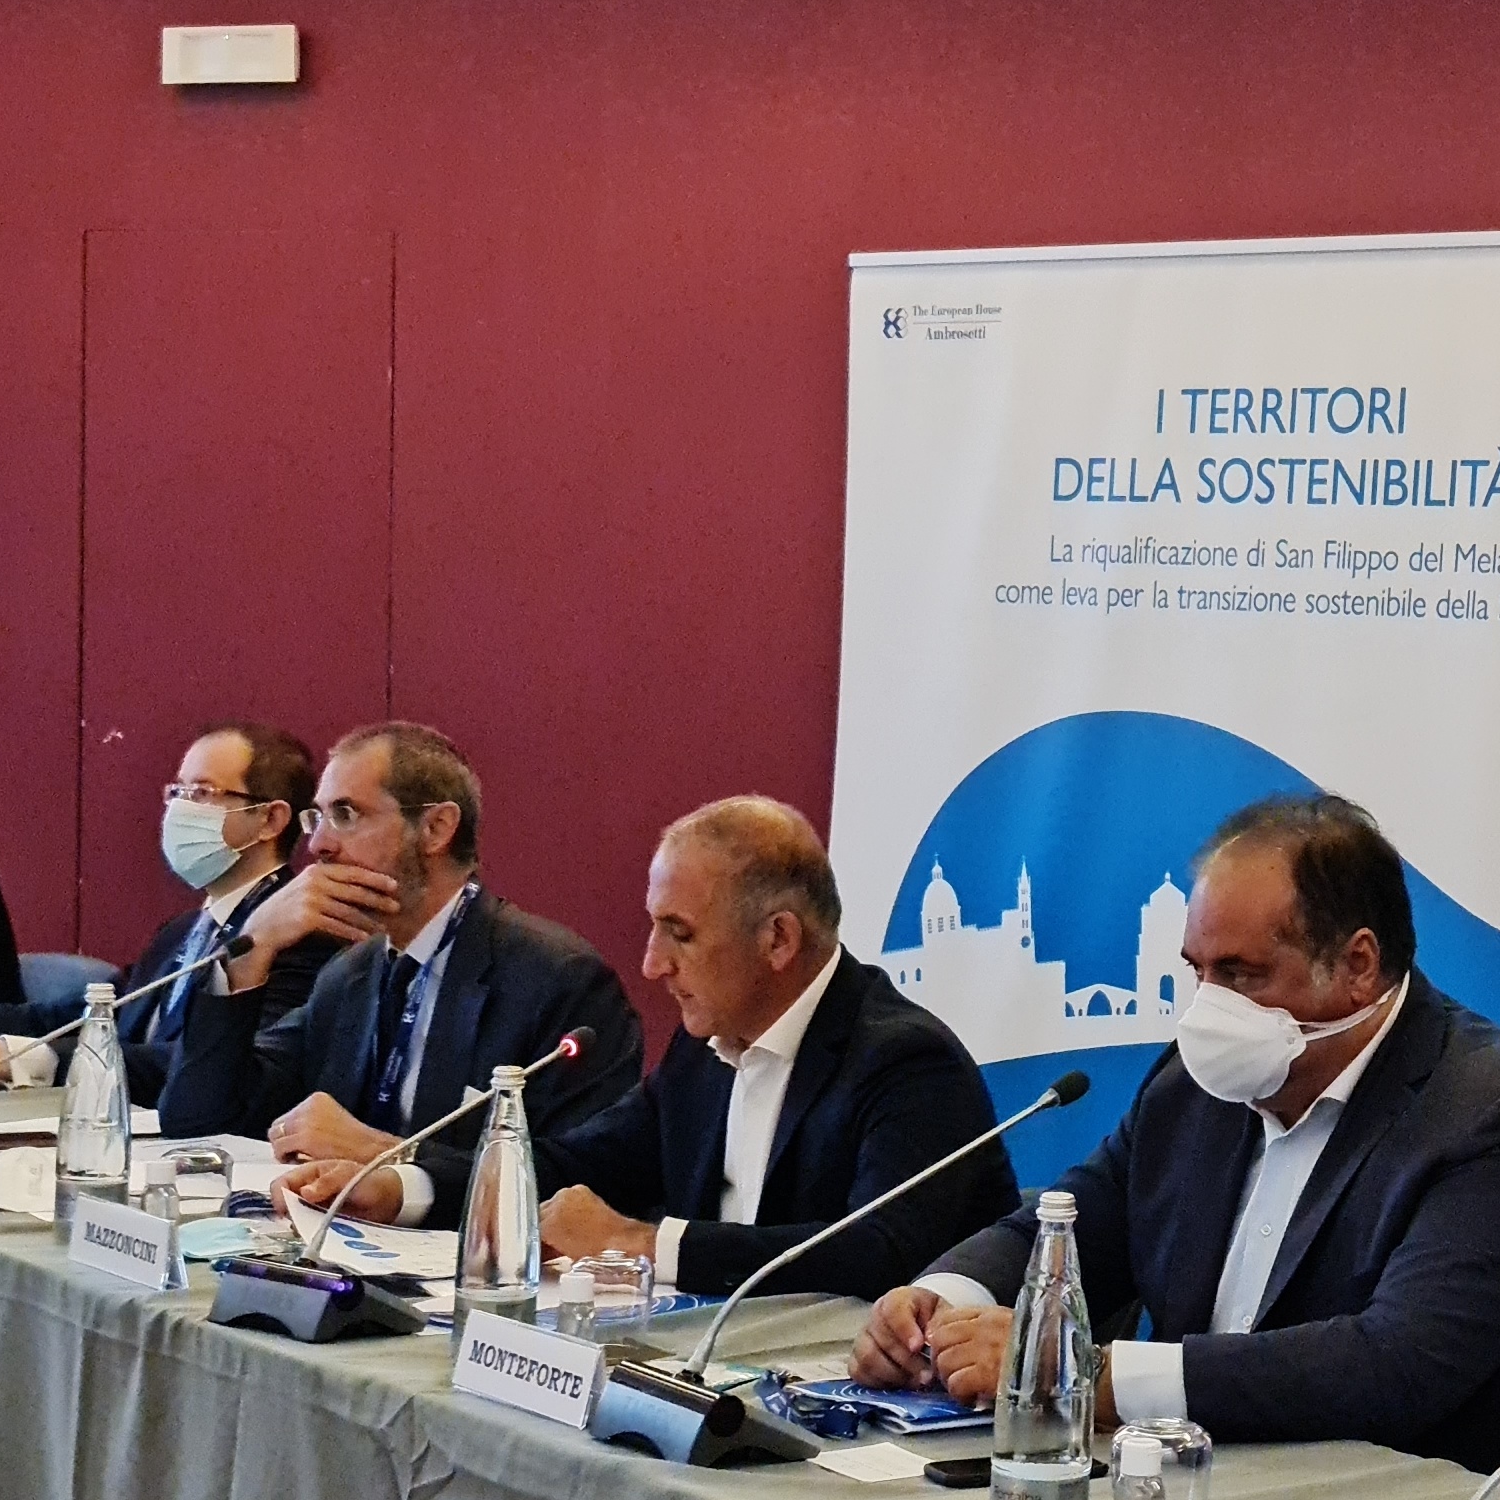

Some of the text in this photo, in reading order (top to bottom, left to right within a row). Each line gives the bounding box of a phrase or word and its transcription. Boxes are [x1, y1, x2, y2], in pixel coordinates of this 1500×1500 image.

[912, 303, 1002, 319] The European House
[925, 326, 986, 341] Ambrosetti
[1155, 386, 1407, 436] I TERRITORI
[1052, 457, 1181, 504] DELLA
[1050, 534, 1074, 564] La
[1081, 535, 1239, 574] riqualificazione
[1246, 538, 1266, 568] di
[1274, 538, 1314, 569] San
[1323, 539, 1399, 580] Filippo
[1408, 541, 1444, 573] del
[994, 584, 1054, 607] come
[1061, 578, 1099, 608] leva
[1106, 587, 1145, 615] per
[1152, 579, 1170, 609] la
[1176, 582, 1297, 614] transizione
[1304, 582, 1427, 618] sostenibile
[1435, 586, 1490, 621] della
[83, 1220, 159, 1265] MAZZONCINI
[467, 1339, 584, 1399] MONTEFORTE
